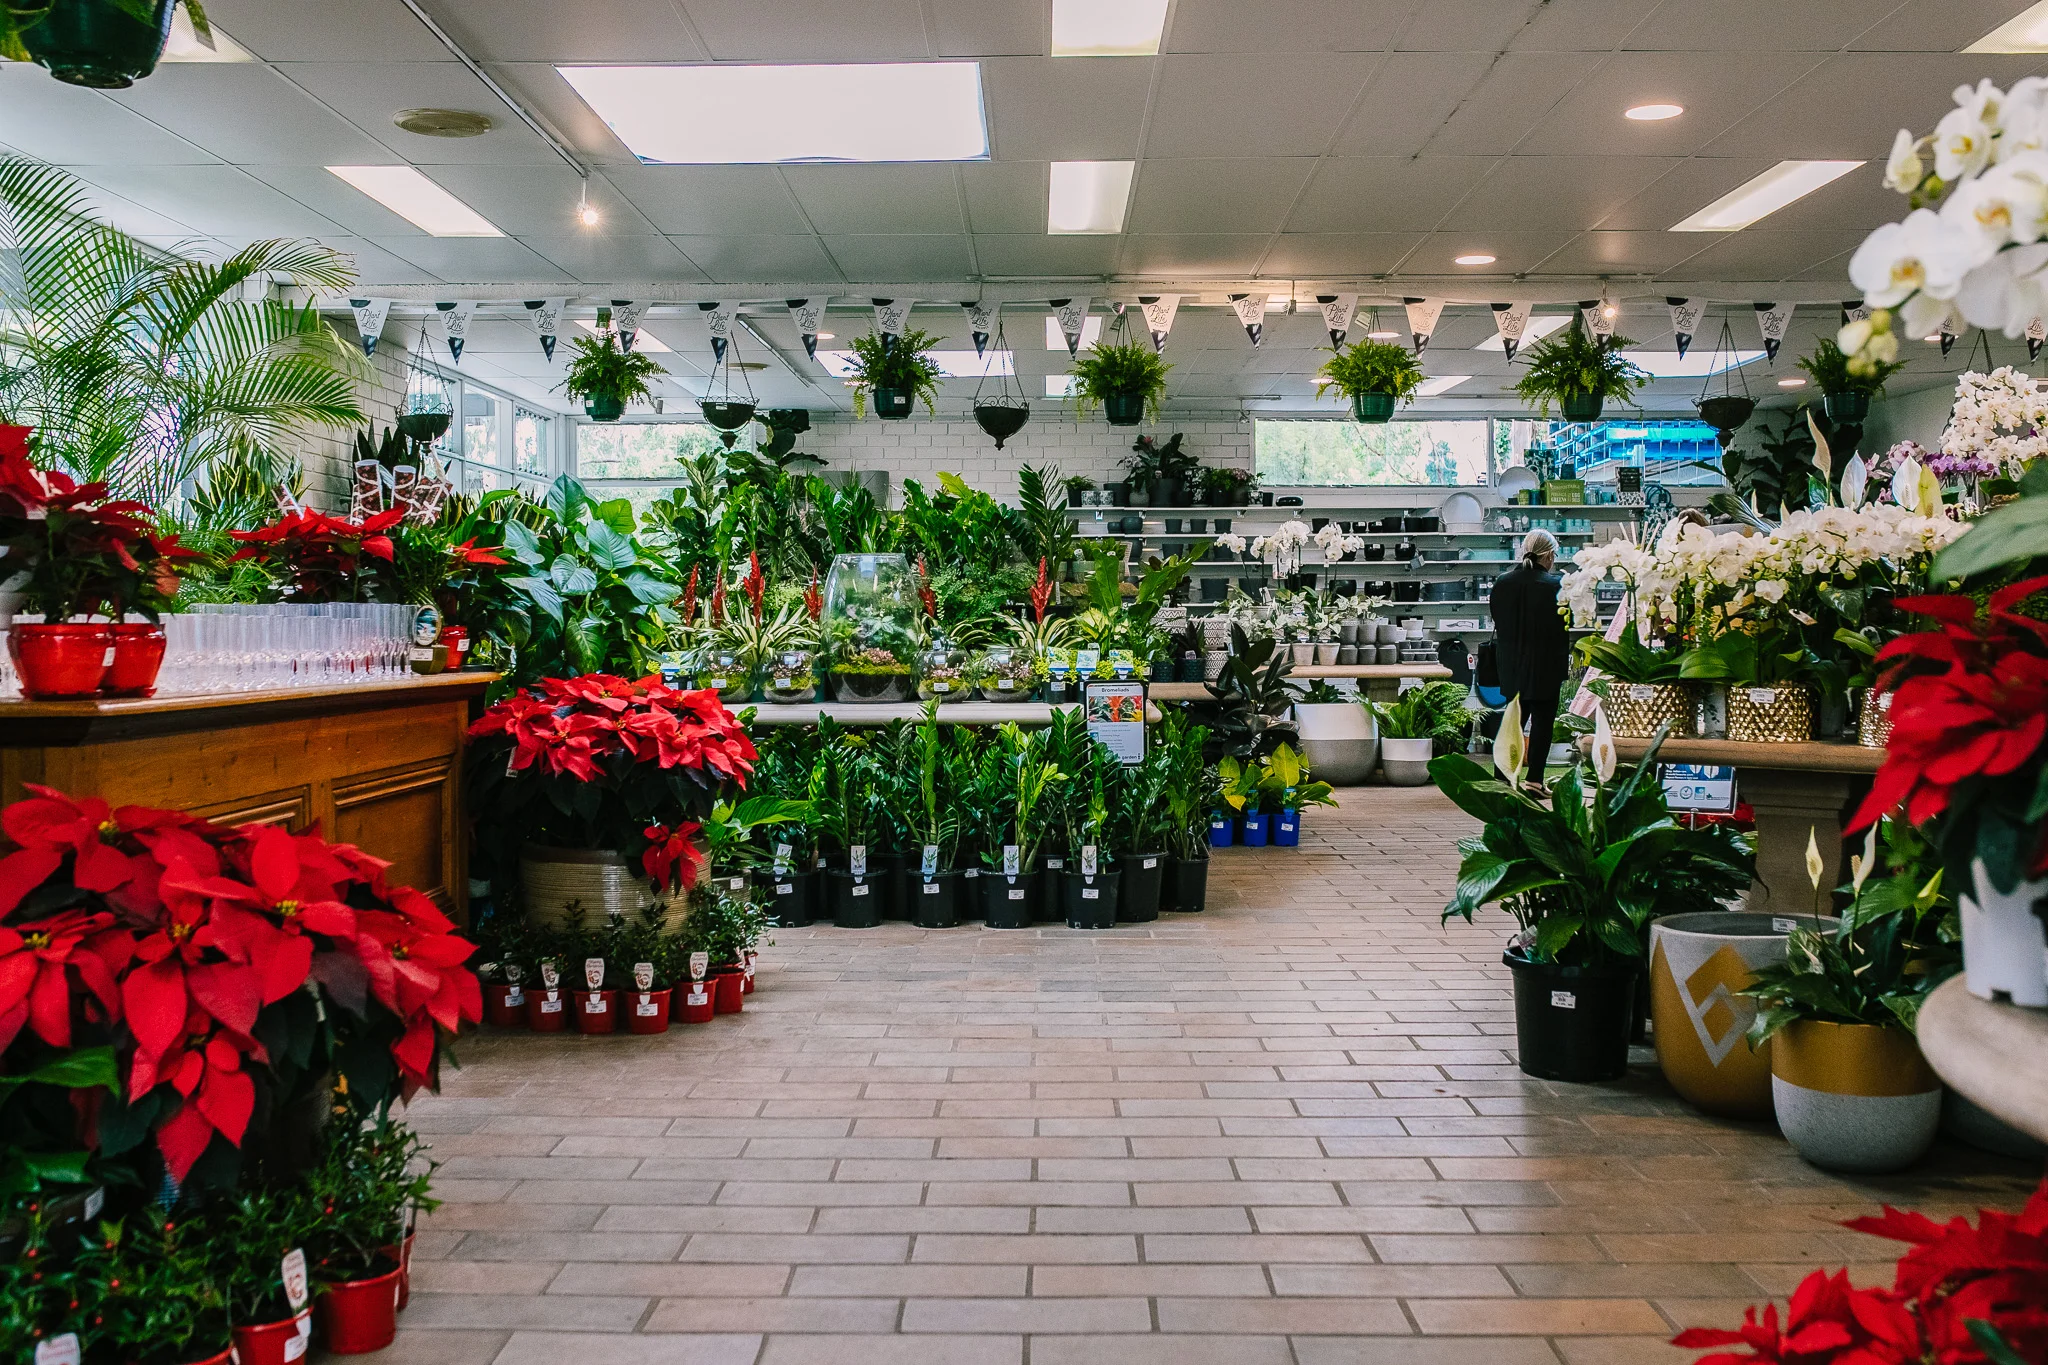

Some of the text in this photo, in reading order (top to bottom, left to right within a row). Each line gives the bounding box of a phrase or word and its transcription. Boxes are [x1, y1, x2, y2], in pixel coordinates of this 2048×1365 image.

[1147, 304, 1171, 317] Plant
[1238, 298, 1261, 313] Plant
[1325, 303, 1349, 316] Plant
[358, 308, 381, 321] Plant
[444, 311, 468, 324] Plant
[534, 309, 557, 323] Plant
[618, 307, 641, 318] Plant
[707, 311, 731, 324] Plant
[796, 307, 819, 321] Plant
[879, 307, 903, 319] Plant
[1059, 307, 1082, 320] Plant
[1242, 306, 1259, 318] Life
[1328, 312, 1346, 323] Life
[1674, 306, 1698, 319] Plant
[1762, 311, 1786, 325] Plant
[538, 318, 554, 329] Life
[620, 314, 636, 326] Life
[800, 316, 816, 328] Life
[881, 316, 898, 327] Life
[971, 316, 989, 326] Life
[1062, 316, 1079, 327] Life
[1150, 313, 1167, 324] Life
[1500, 312, 1523, 325] Plant
[1593, 317, 1609, 328] Life
[1676, 314, 1692, 327] Life
[447, 320, 463, 331] Life
[710, 319, 726, 331] Life
[1502, 320, 1520, 332] Life
[1764, 320, 1780, 333] Life
